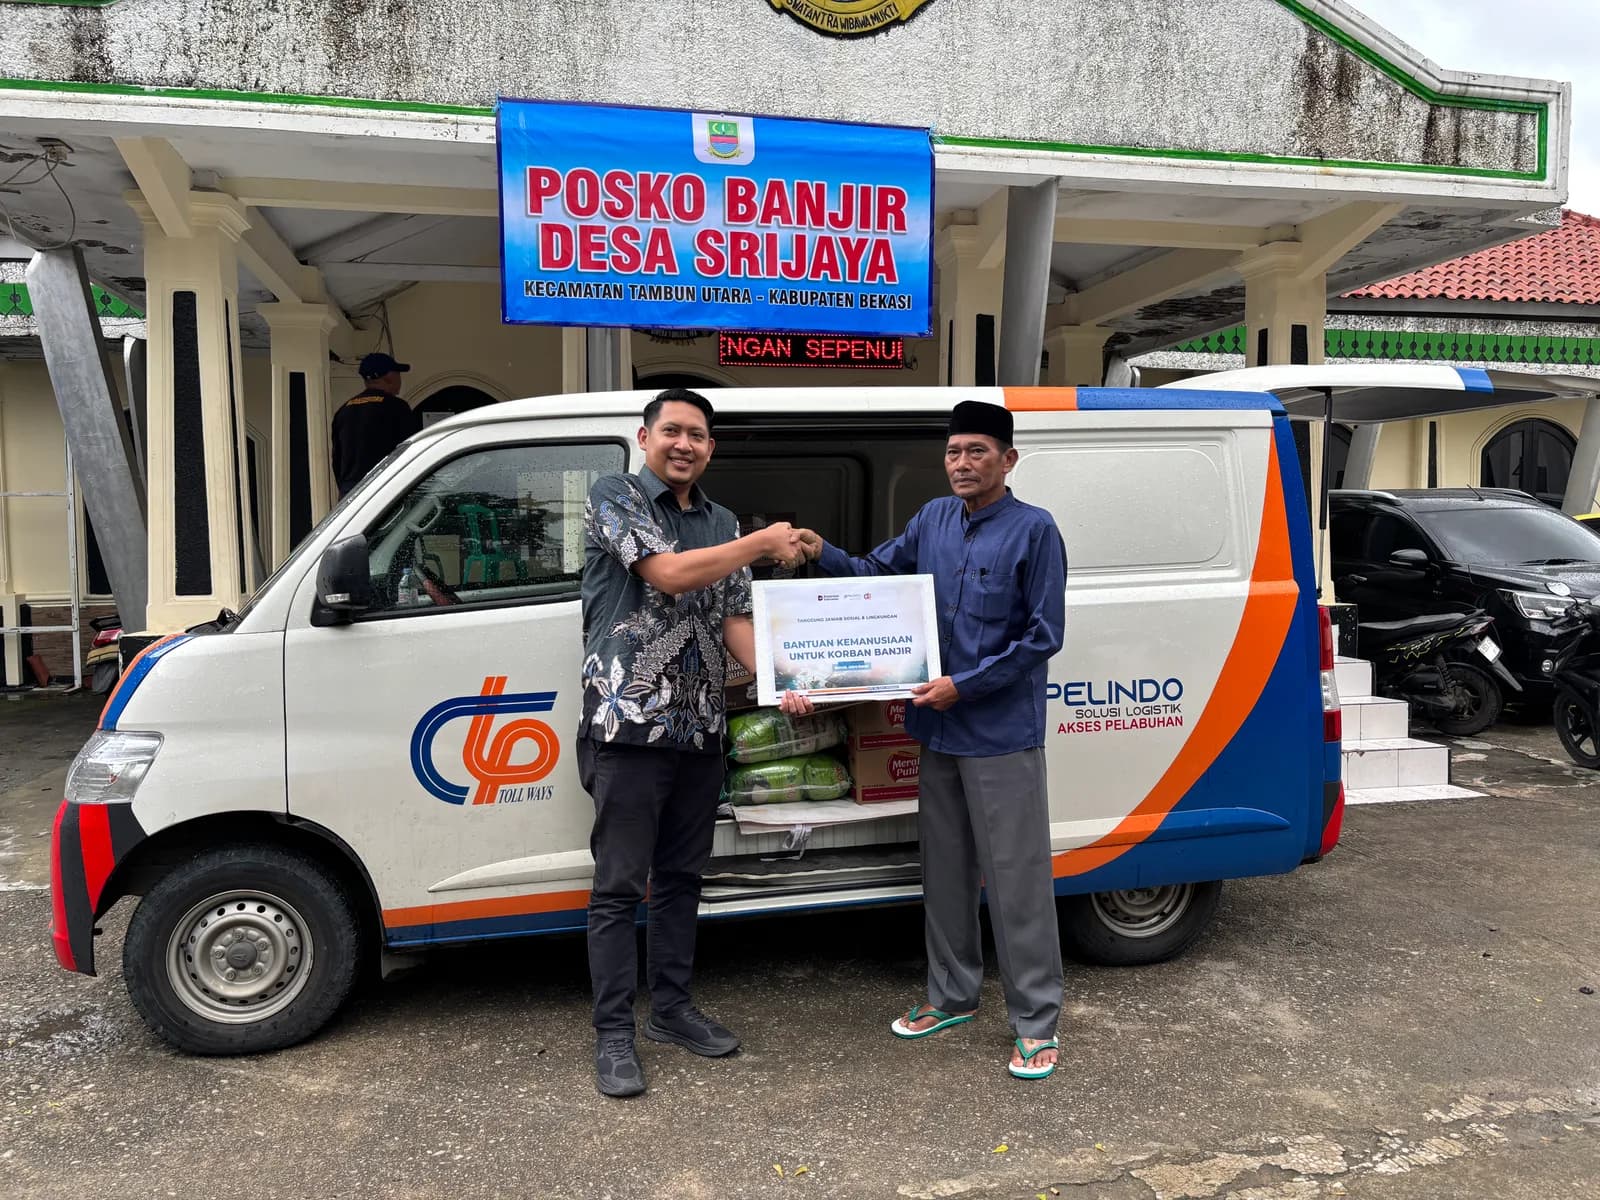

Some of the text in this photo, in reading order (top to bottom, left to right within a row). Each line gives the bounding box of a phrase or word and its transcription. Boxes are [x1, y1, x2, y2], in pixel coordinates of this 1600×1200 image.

[840, 15, 872, 30] WIBAWA
[870, 2, 899, 25] MUKTI
[526, 166, 908, 232] POSKO BANJIR
[539, 222, 899, 284] DESA SRIJAYA
[524, 280, 623, 300] KECAMATAN
[629, 284, 696, 302] TAMBUN
[702, 287, 751, 304] UTARA
[769, 289, 854, 308] KABUPATEN
[859, 293, 912, 310] BEKASI
[783, 635, 913, 649] BANTUAN KEMANUSIAAN
[789, 646, 912, 660] UNTUK KORBAN BANJIR
[1047, 678, 1184, 706] PELINDO
[1075, 704, 1182, 719] SOLUSI LOGISTIK
[1057, 716, 1183, 734] AKSES PELABUHAN
[499, 786, 554, 804] TOLL WAYS
